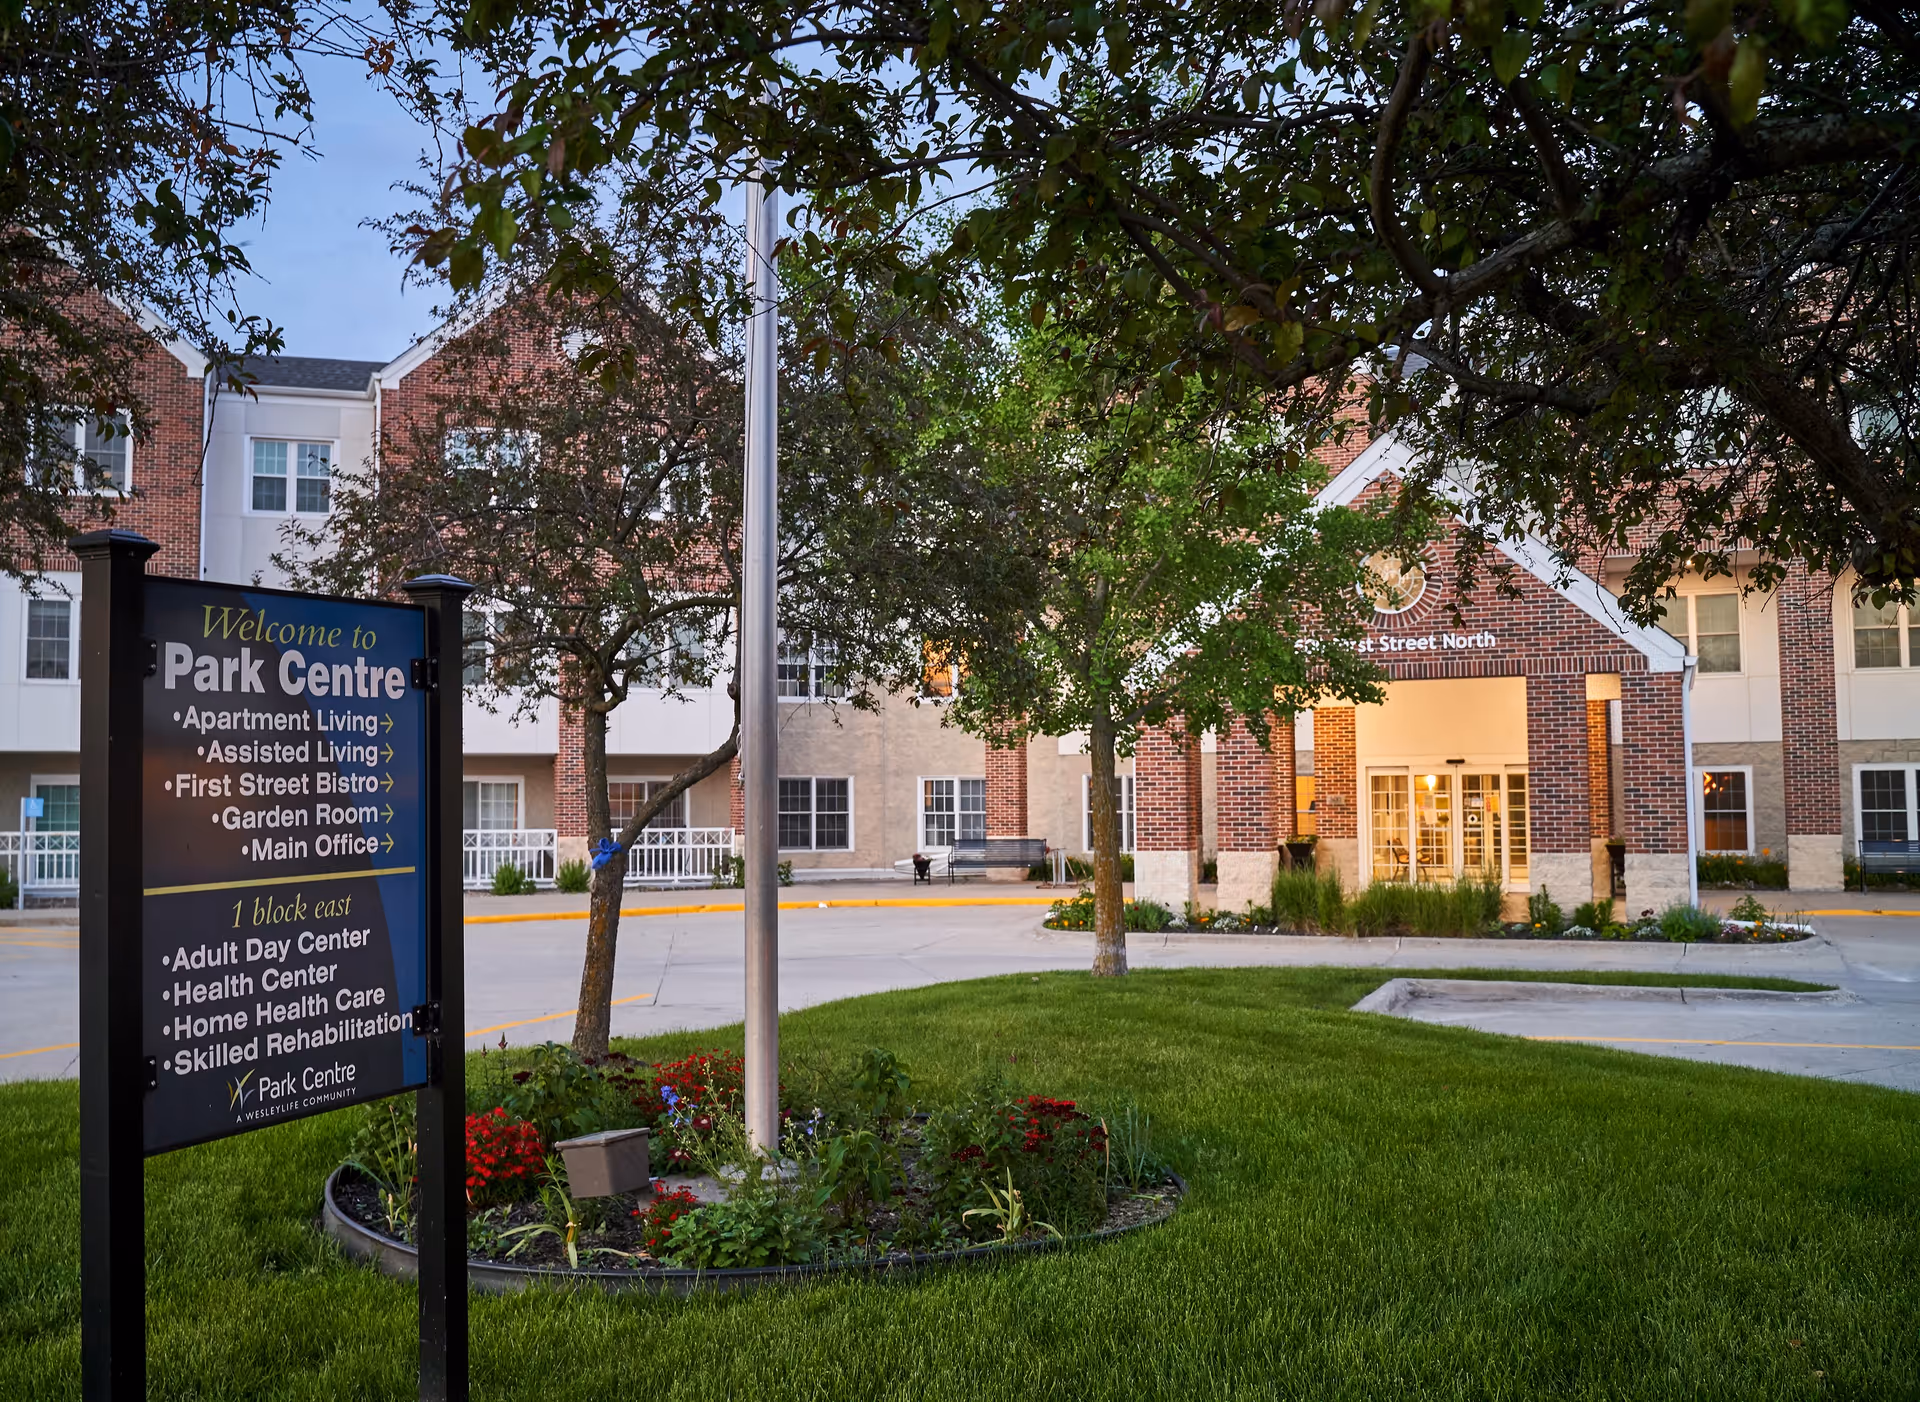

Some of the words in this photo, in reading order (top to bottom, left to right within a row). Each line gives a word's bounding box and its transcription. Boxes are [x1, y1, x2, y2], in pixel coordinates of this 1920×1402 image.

[202, 605, 342, 648] Welcome
[352, 625, 377, 650] to
[1380, 636, 1436, 651] Street
[1443, 631, 1495, 649] North
[164, 641, 266, 693] Park
[278, 650, 405, 699] Centre
[182, 705, 310, 735] Apartment
[317, 710, 378, 737] Living
[206, 740, 309, 763] Assisted
[317, 740, 378, 767] Living
[176, 774, 232, 798] First
[239, 772, 309, 796] Street
[316, 772, 378, 794] Bistro
[222, 805, 308, 830] Garden
[316, 803, 378, 825] Room
[252, 837, 308, 861] Main
[315, 834, 379, 857] Office
[232, 900, 242, 928] 1
[253, 893, 308, 927] block
[315, 894, 352, 919] east
[172, 942, 238, 972] Adult
[246, 938, 291, 962] Day
[297, 928, 371, 954] Center
[174, 973, 254, 1007] Health
[262, 964, 338, 992] Center
[174, 1010, 248, 1041] Home
[256, 996, 328, 1026] Health
[335, 987, 386, 1011] Care
[174, 1037, 258, 1075] Skilled
[267, 1011, 413, 1057] Rehabilitation
[260, 1072, 296, 1101] Park
[303, 1061, 356, 1091] Centre
[236, 1115, 242, 1123] A
[245, 1101, 299, 1120] WESLEYLIFE
[303, 1087, 356, 1107] COMMUNITY
